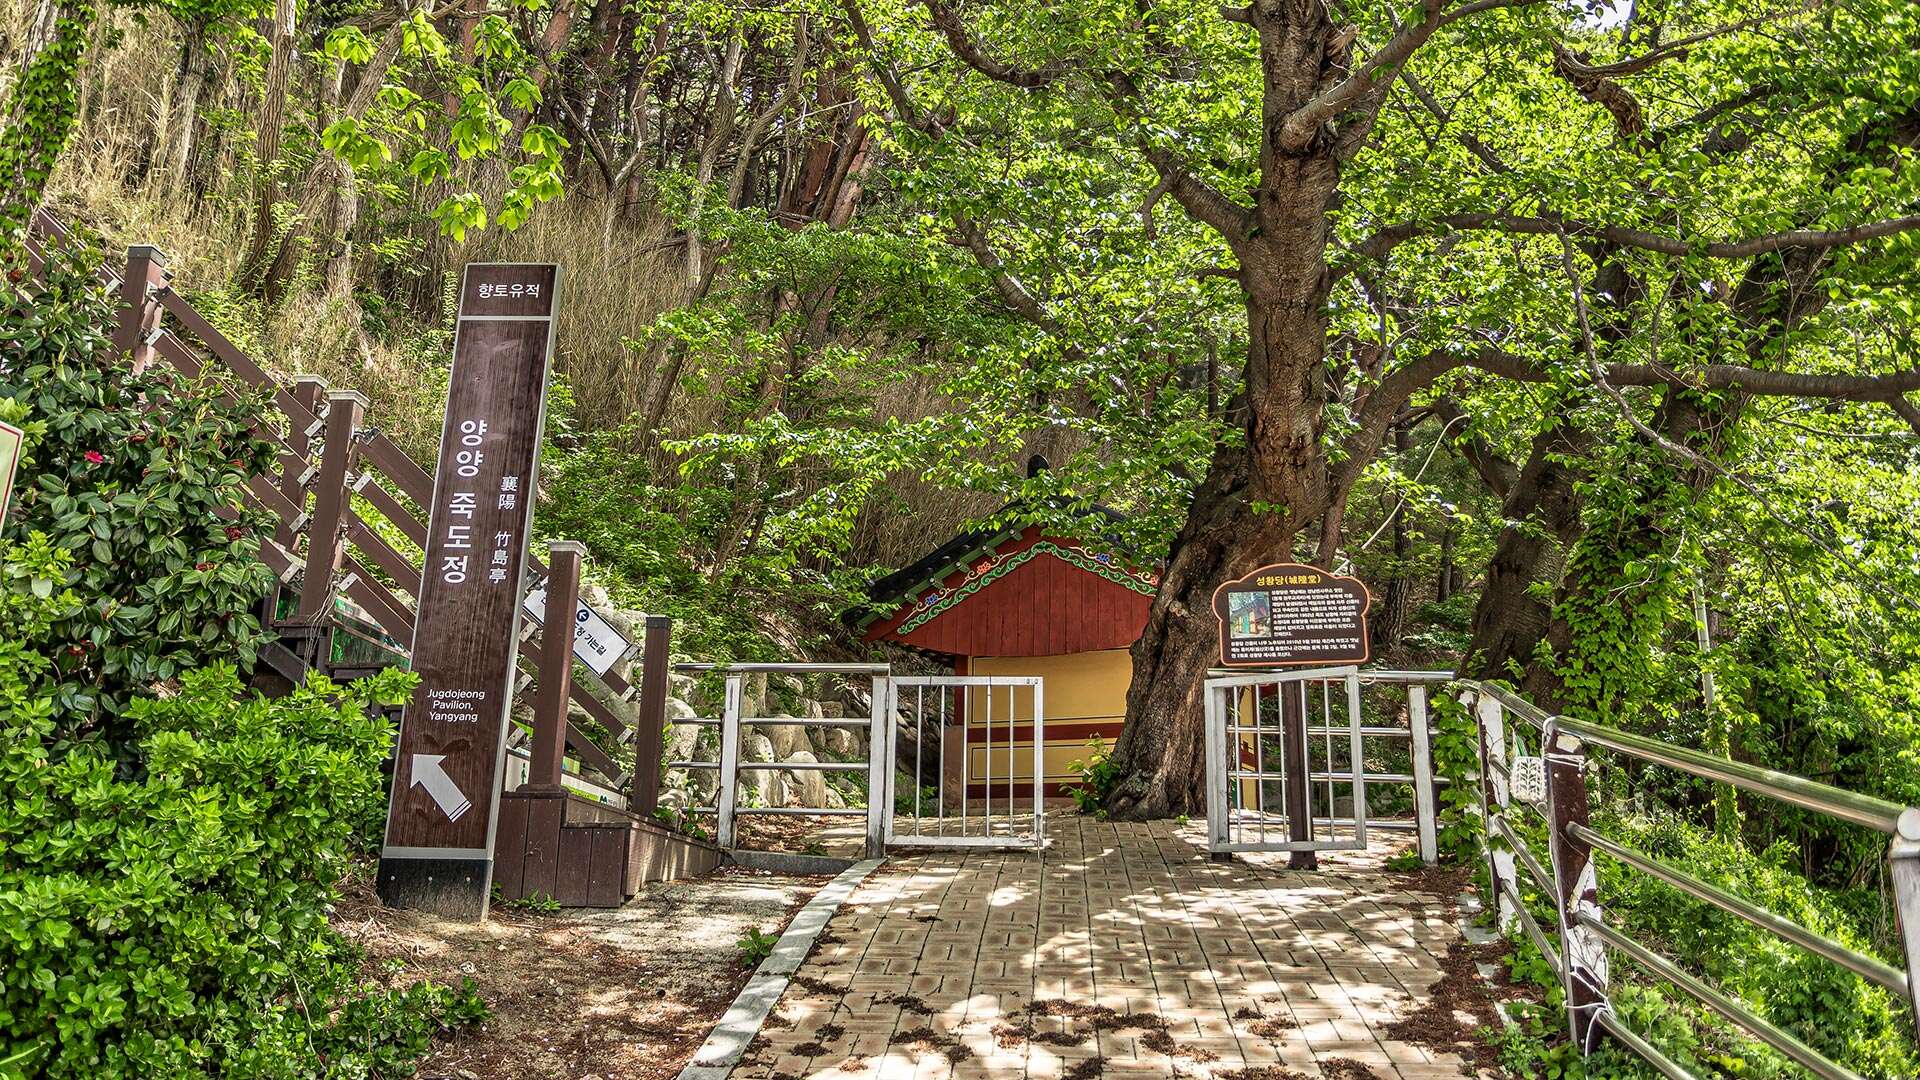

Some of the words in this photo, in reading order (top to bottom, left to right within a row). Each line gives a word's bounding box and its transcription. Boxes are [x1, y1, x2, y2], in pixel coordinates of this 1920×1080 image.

[478, 283, 540, 299] 향토유적
[456, 419, 488, 477] 양양
[498, 476, 519, 510] 襄陽
[441, 492, 477, 584] 죽도정
[488, 531, 511, 584] 竹島亭
[427, 689, 486, 700] Jugdojeong
[432, 700, 474, 711] Pavilion,
[429, 711, 479, 723] Yangyang
